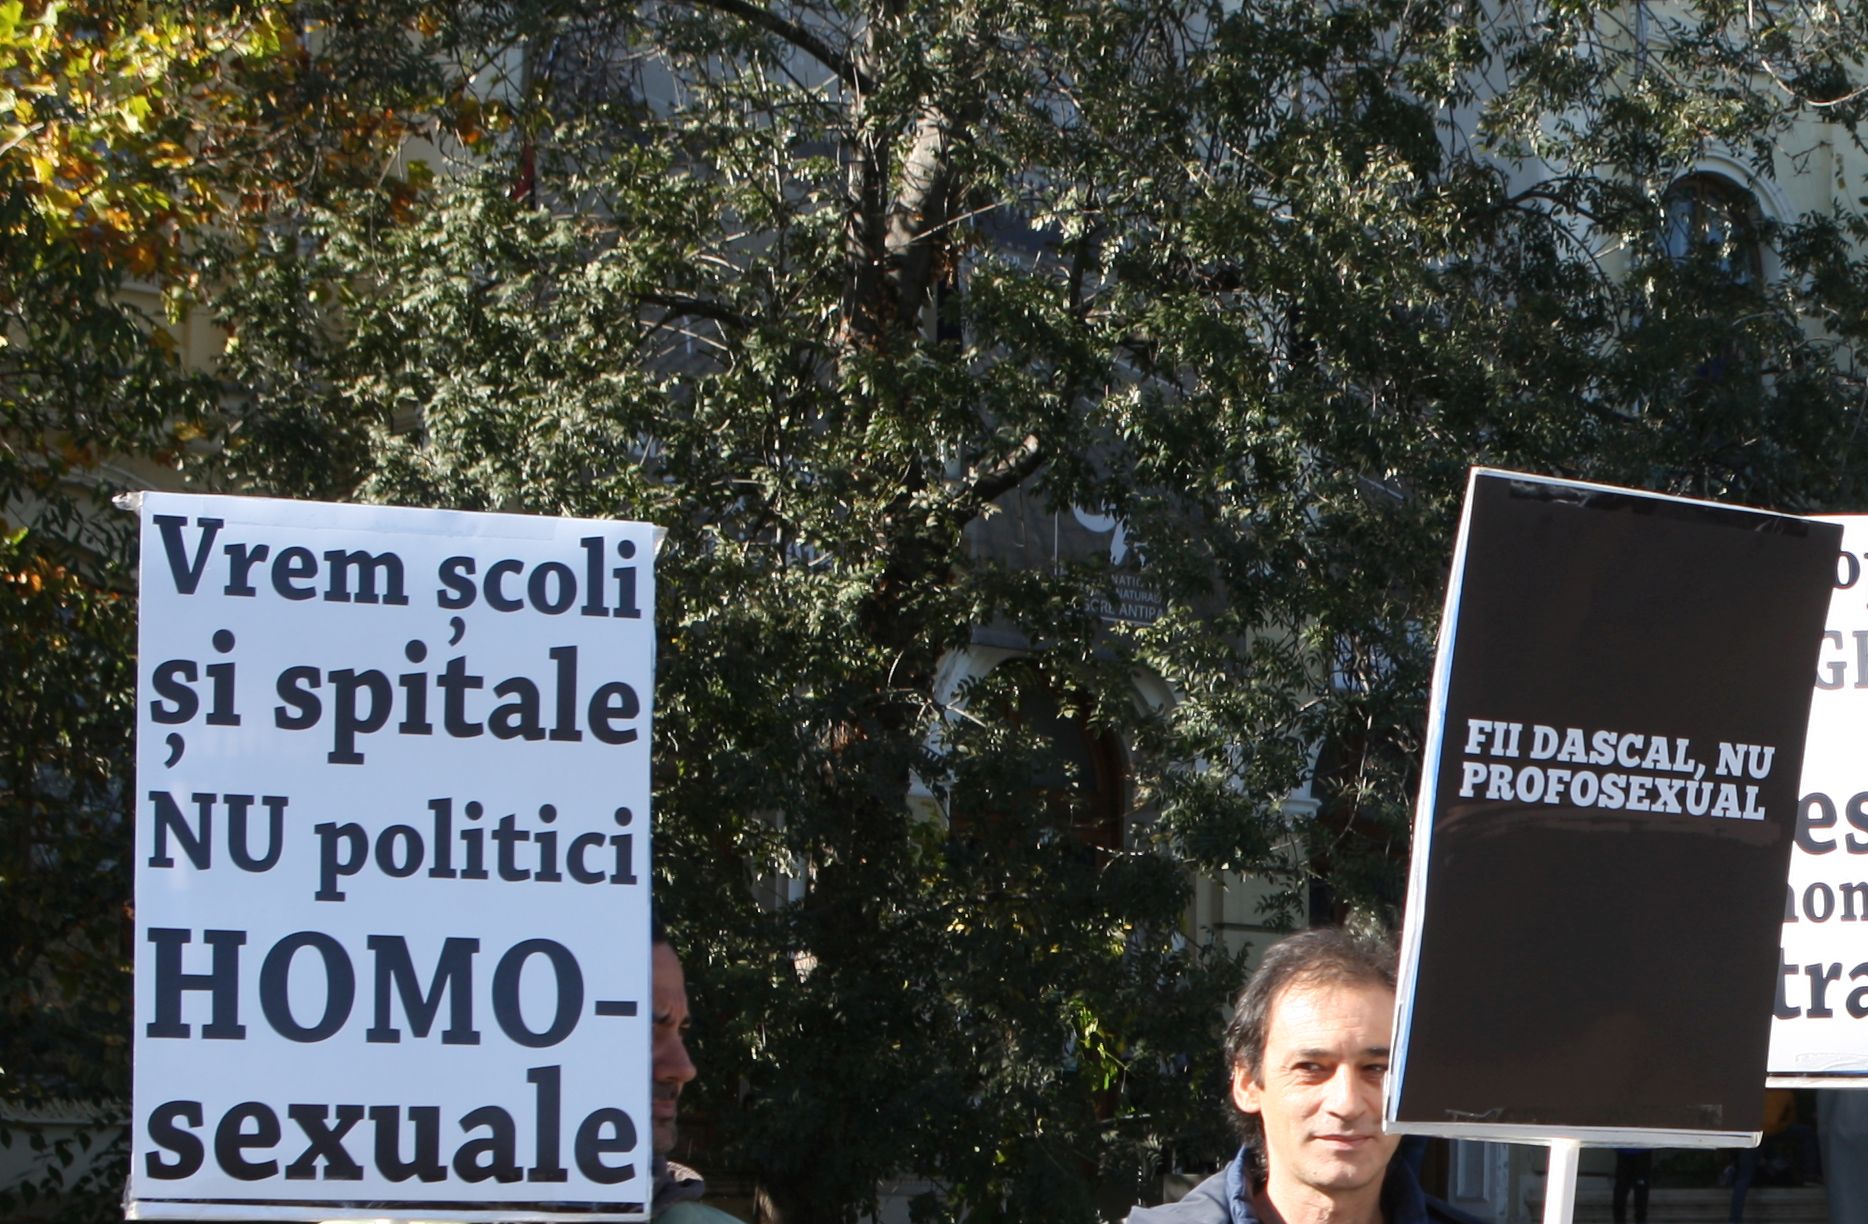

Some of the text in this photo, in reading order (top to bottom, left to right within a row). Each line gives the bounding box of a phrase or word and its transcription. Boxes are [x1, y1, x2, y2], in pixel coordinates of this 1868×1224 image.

[153, 515, 641, 646] Vrem școli
[1118, 602, 1163, 619] ANTIPA
[150, 629, 639, 768] și spitale
[1465, 719, 1775, 781] FII DASCAL, NU
[149, 791, 637, 901] NU politici
[1459, 762, 1765, 820] PROFOSEXUAL
[147, 928, 637, 1048] HOMO-
[146, 1065, 637, 1184] sexuale
